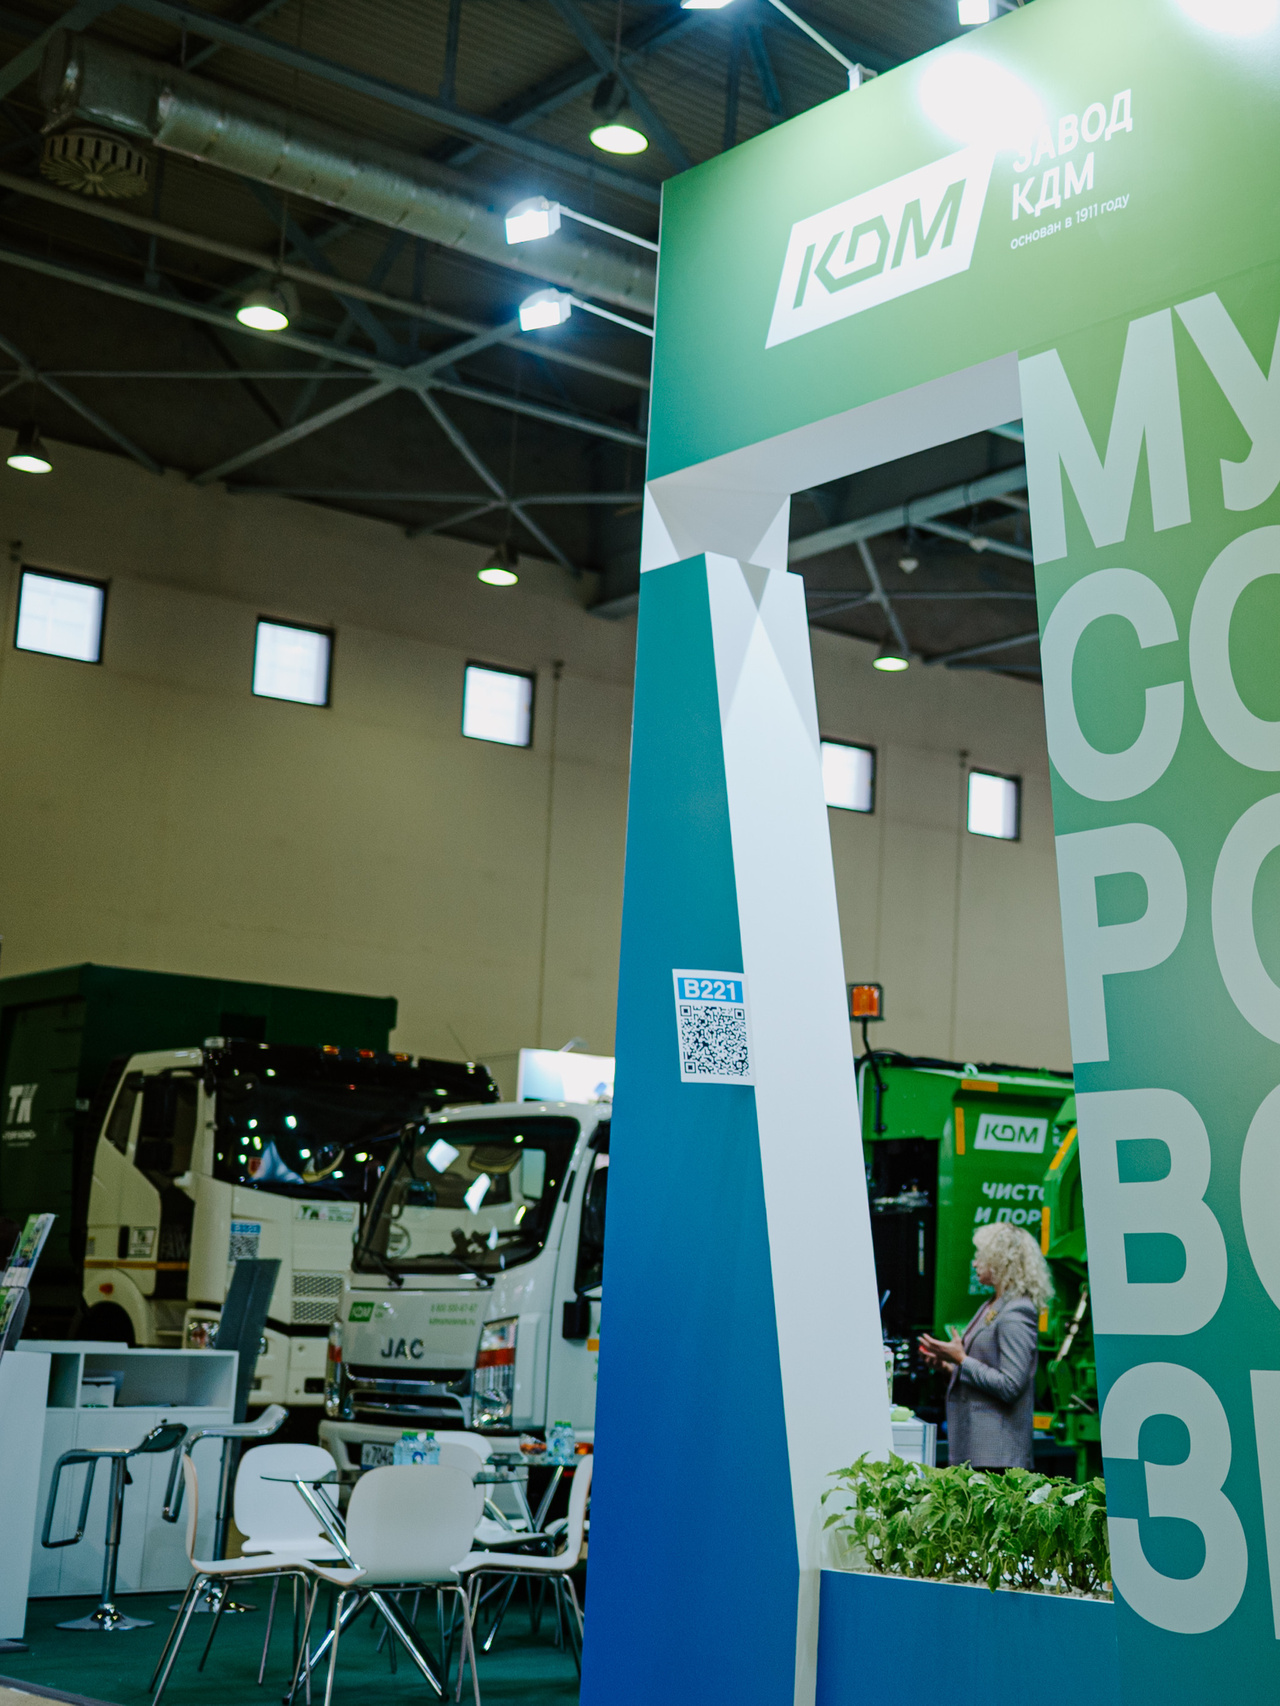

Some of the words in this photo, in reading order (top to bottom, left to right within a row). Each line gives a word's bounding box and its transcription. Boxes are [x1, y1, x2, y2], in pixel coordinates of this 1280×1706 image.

[1012, 88, 1133, 173] ЗАВОД
[1012, 151, 1094, 221] КДМ
[1010, 221, 1061, 250] основан
[1065, 216, 1072, 229] в
[1075, 203, 1098, 223] 1911
[1100, 193, 1130, 213] году
[792, 177, 967, 310] KDM
[683, 979, 736, 1000] B221
[984, 1123, 1039, 1144] KDM
[974, 1206, 992, 1223] И
[381, 1337, 424, 1360] JAC
